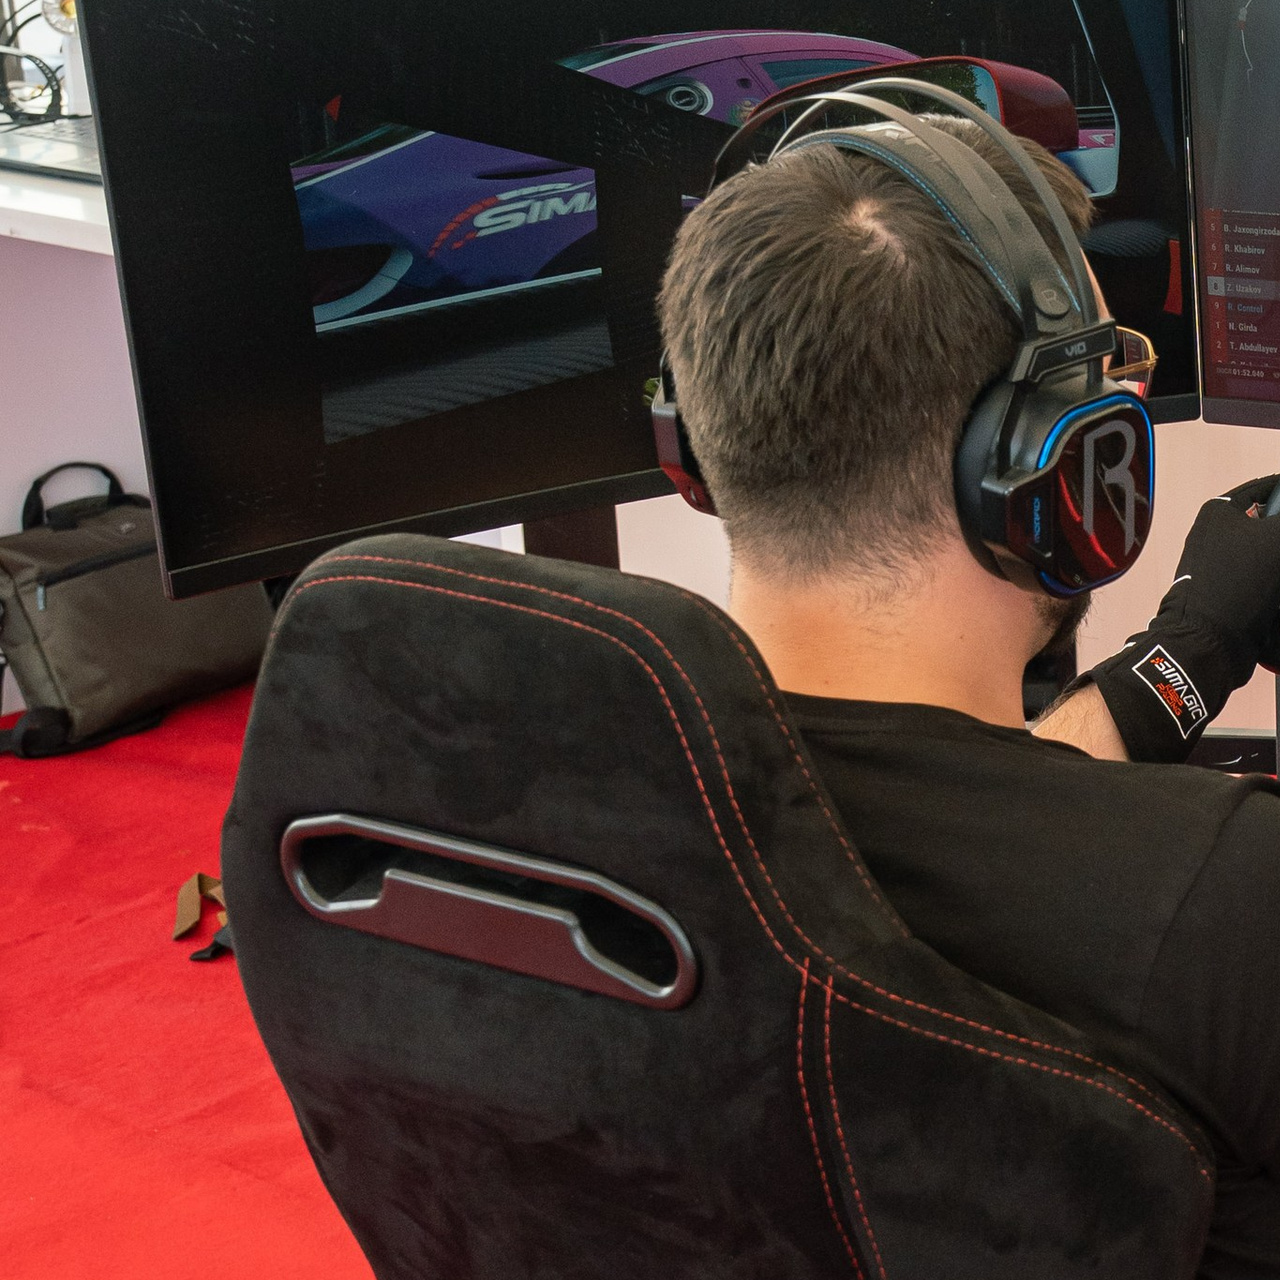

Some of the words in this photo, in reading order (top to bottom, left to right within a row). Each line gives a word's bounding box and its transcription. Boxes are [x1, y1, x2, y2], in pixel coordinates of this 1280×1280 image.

[1234, 244, 1266, 255] Khabirov
[1235, 264, 1261, 275] Alimov
[1235, 284, 1262, 295] Uzakov
[1237, 304, 1263, 314] Control
[1238, 323, 1258, 333] Girda
[1239, 343, 1278, 354] Abdullayev
[1152, 658, 1203, 720] SIMAGIC
[1156, 682, 1183, 716] RACING
